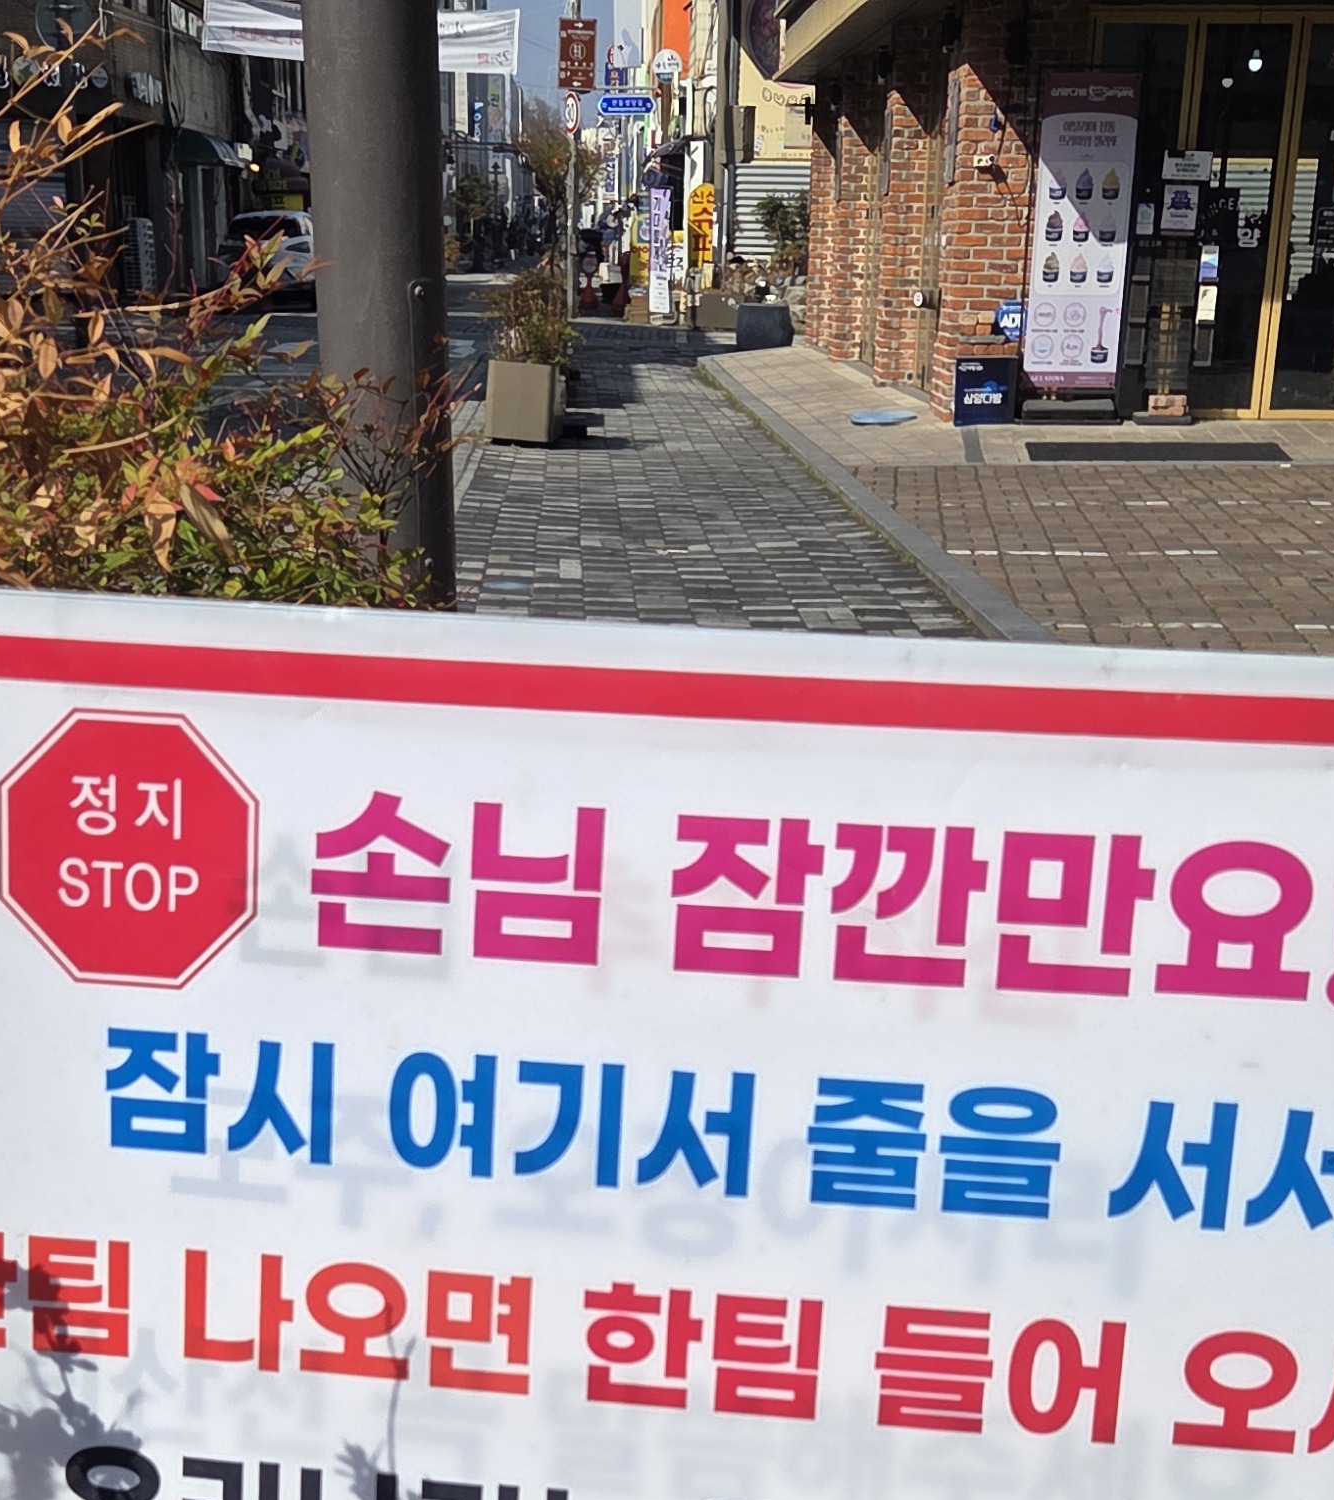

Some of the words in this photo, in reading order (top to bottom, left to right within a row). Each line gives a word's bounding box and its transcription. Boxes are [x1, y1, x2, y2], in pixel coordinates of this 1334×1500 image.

[57, 856, 200, 915] STOP
[310, 790, 606, 967] 손님
[104, 1027, 336, 1167] 잠시
[387, 1051, 756, 1198] 여기서
[806, 1076, 1062, 1221] 줄을
[182, 1248, 533, 1396] 나오면
[583, 1280, 825, 1422] 한팀
[873, 1304, 1127, 1444] 들어
